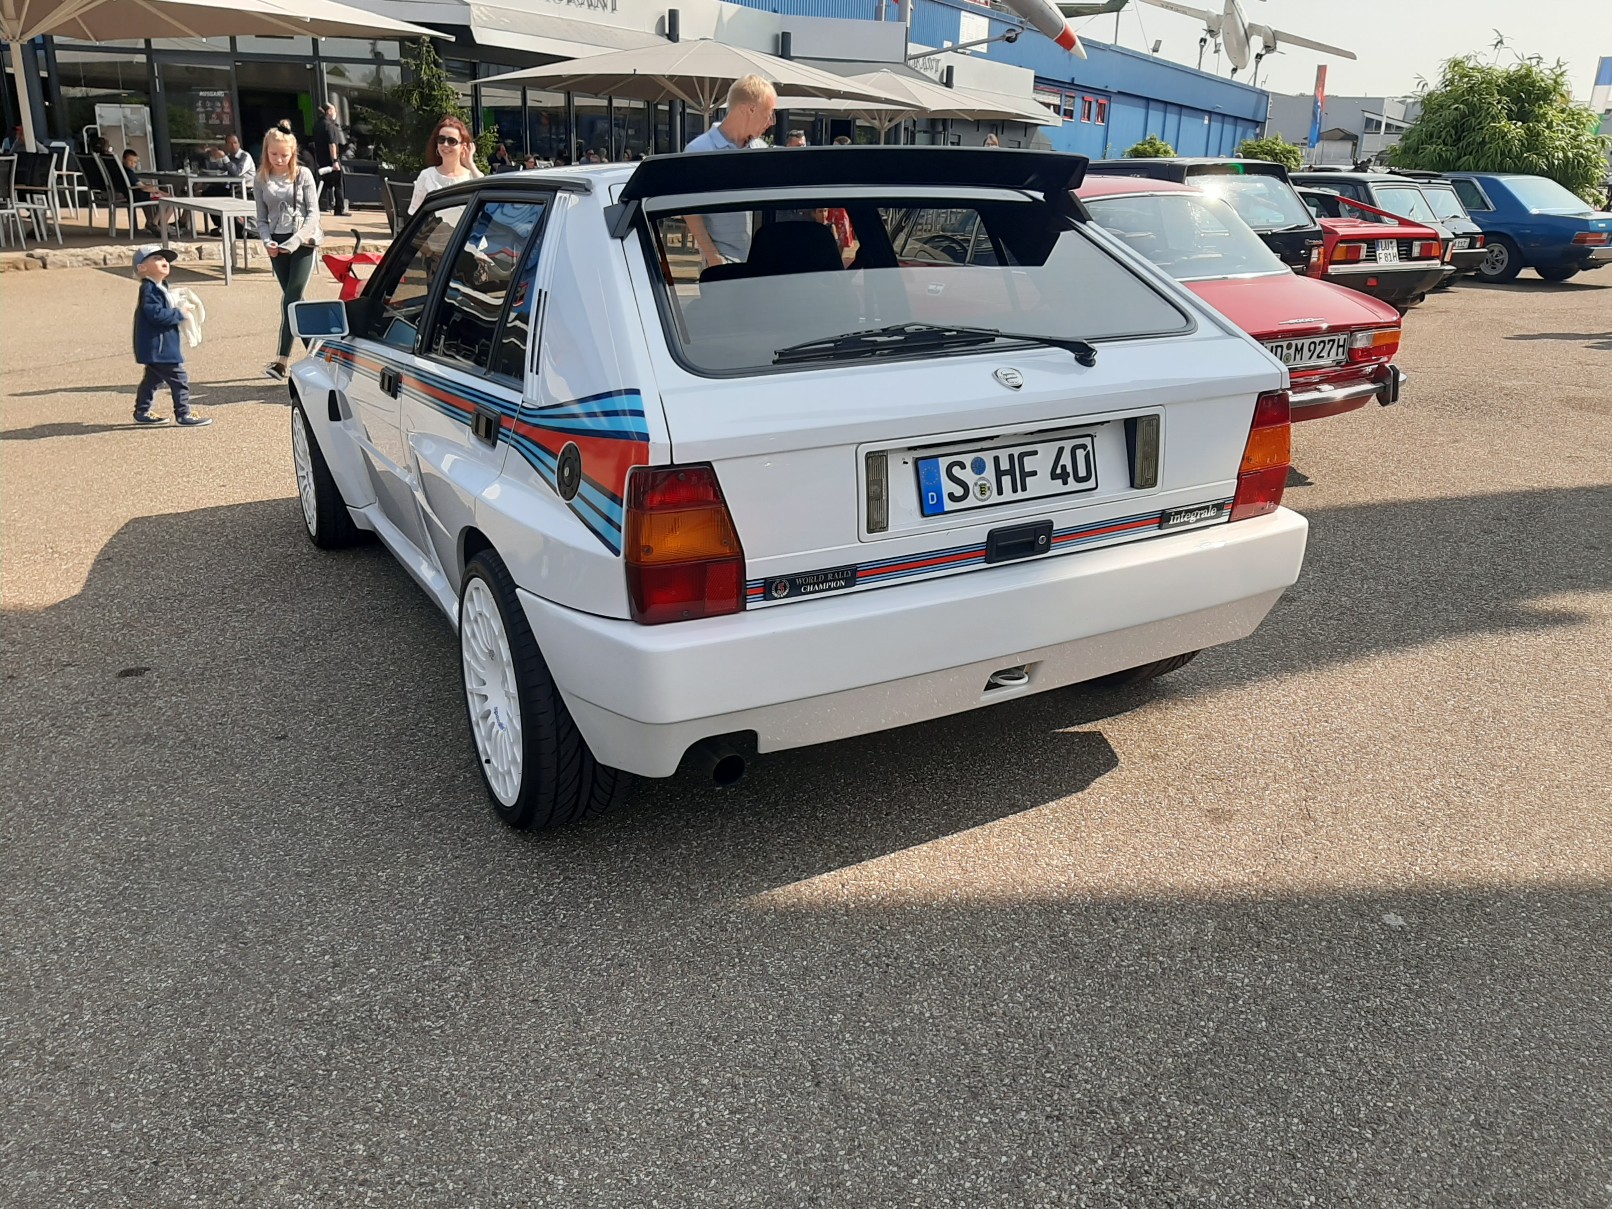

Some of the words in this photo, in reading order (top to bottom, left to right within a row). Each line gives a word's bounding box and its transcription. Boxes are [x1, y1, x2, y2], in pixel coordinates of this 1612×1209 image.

[1293, 342, 1304, 361] M
[1308, 337, 1347, 360] 927H
[945, 460, 970, 502] S
[993, 449, 1039, 496] HF
[1050, 443, 1092, 486] 40
[928, 492, 937, 505] D
[1168, 504, 1217, 525] integrale
[795, 573, 824, 585] WORLD
[828, 570, 853, 581] RALLY
[801, 579, 846, 593] CHAMPION
